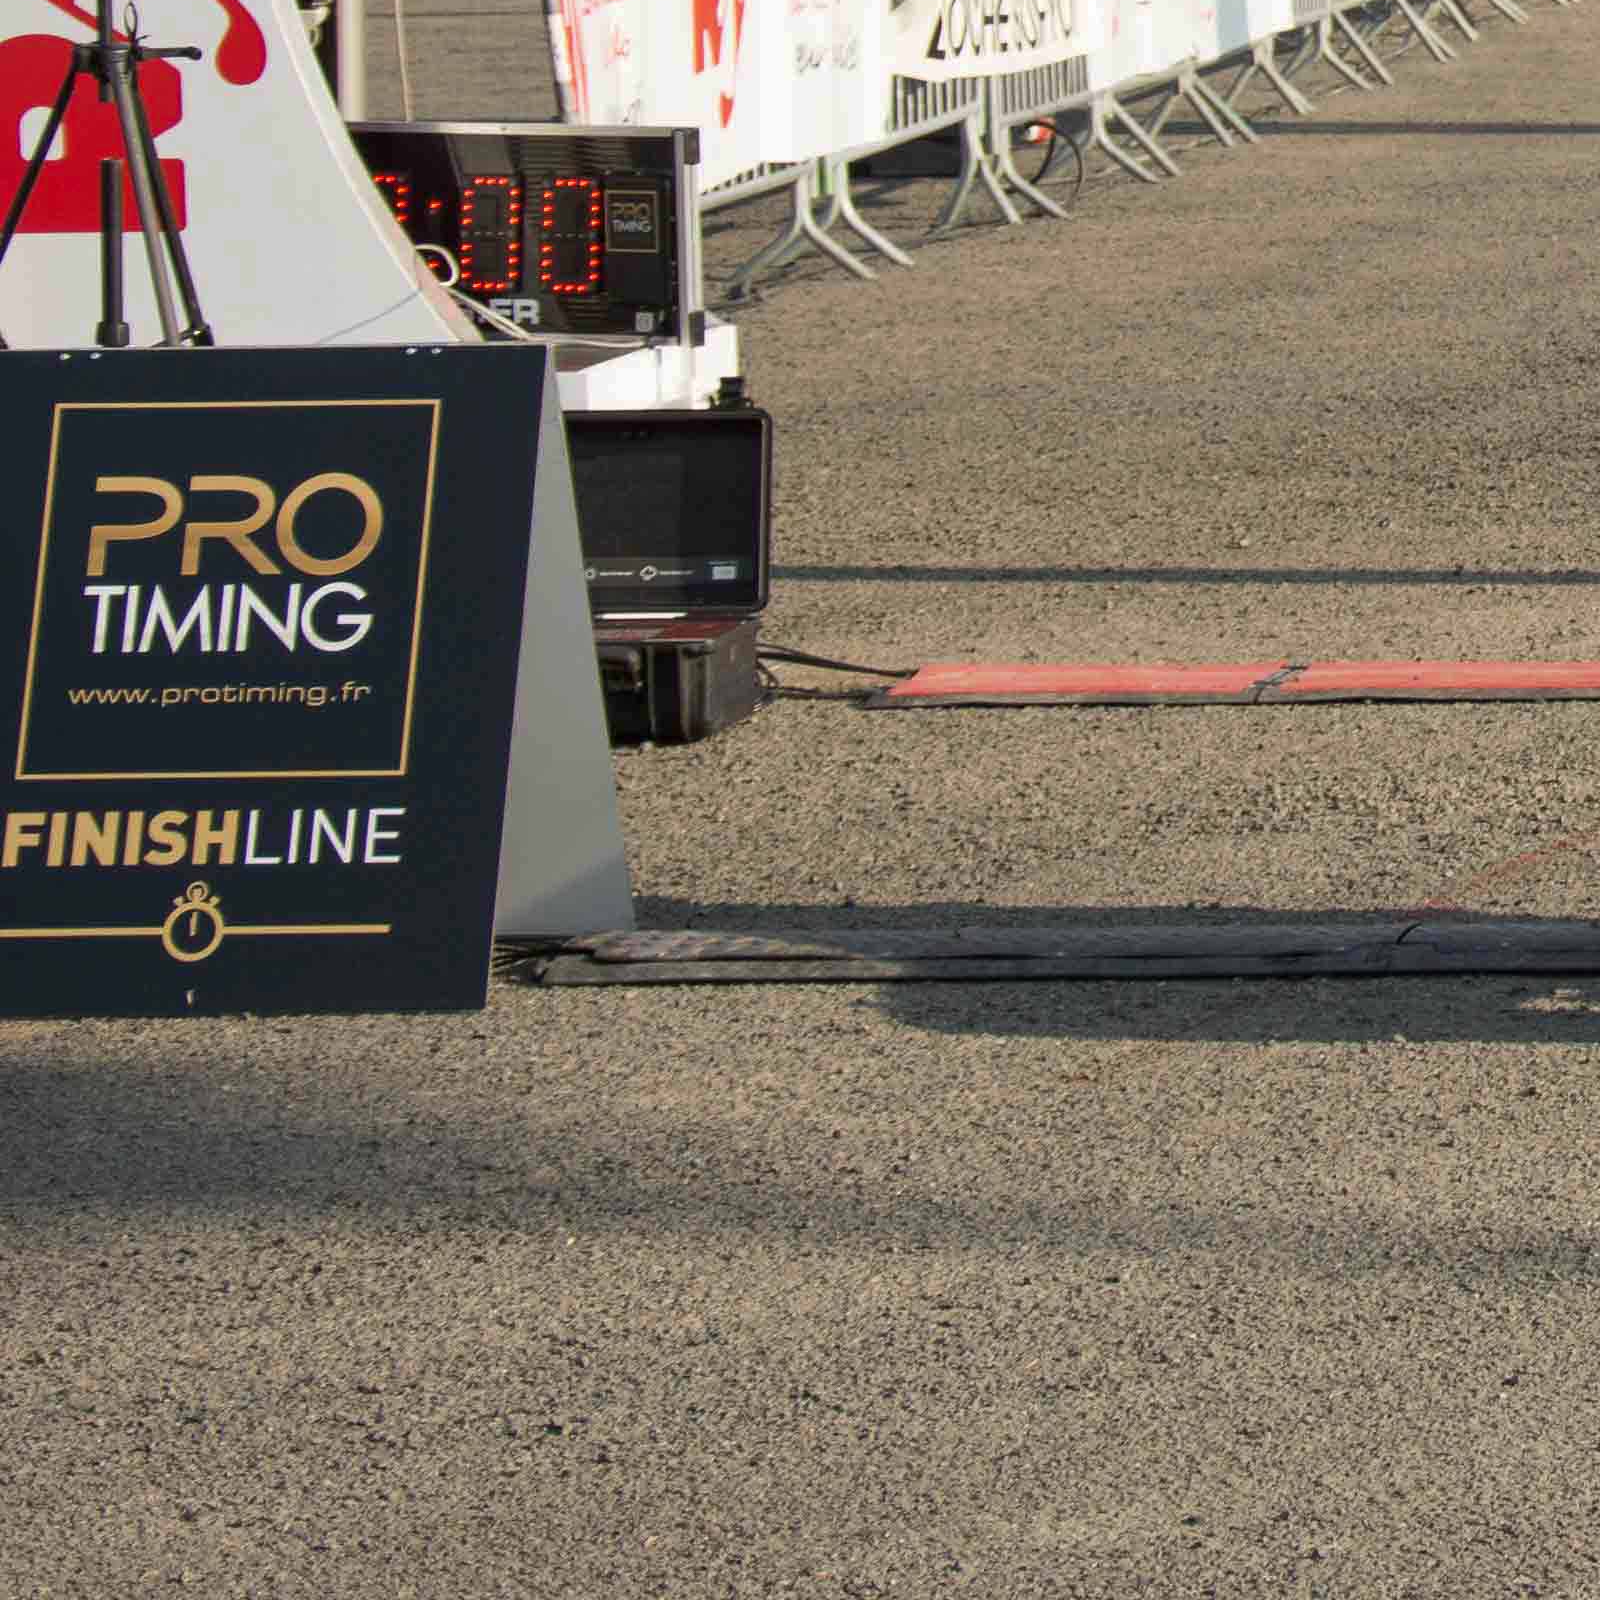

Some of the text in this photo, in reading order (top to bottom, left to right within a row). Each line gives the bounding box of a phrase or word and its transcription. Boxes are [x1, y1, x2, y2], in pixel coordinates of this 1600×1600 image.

[85, 472, 385, 578] PRO
[83, 582, 376, 655] TIMING
[67, 682, 372, 707] www.protiming.fr
[1, 806, 406, 868] FINISHLINE
